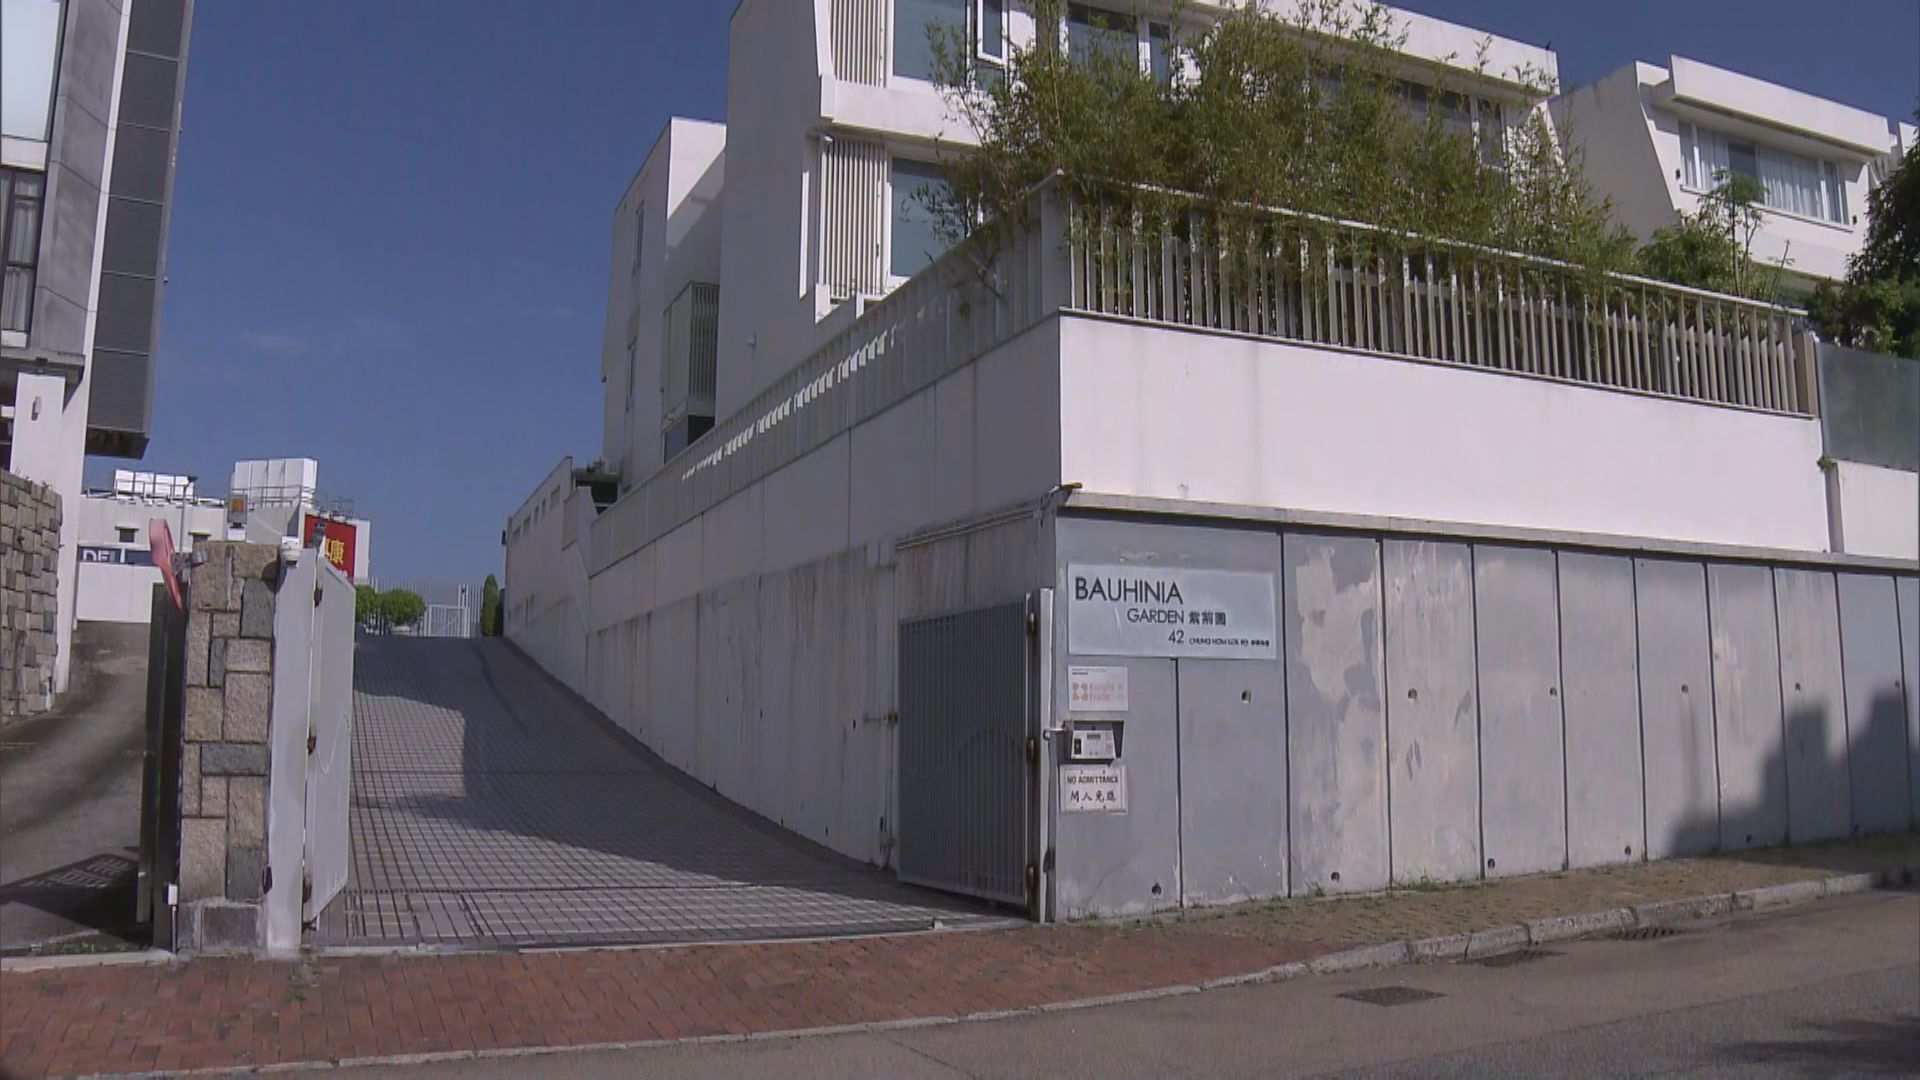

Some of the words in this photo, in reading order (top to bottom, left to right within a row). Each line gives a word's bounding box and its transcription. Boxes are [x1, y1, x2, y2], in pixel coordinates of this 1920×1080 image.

[1075, 577, 1184, 605] BAUHINIA
[1127, 608, 1185, 624] GARDEN
[1168, 630, 1185, 644] 42
[1067, 775, 1077, 784] NO
[1078, 775, 1119, 784] ADMITTANCE
